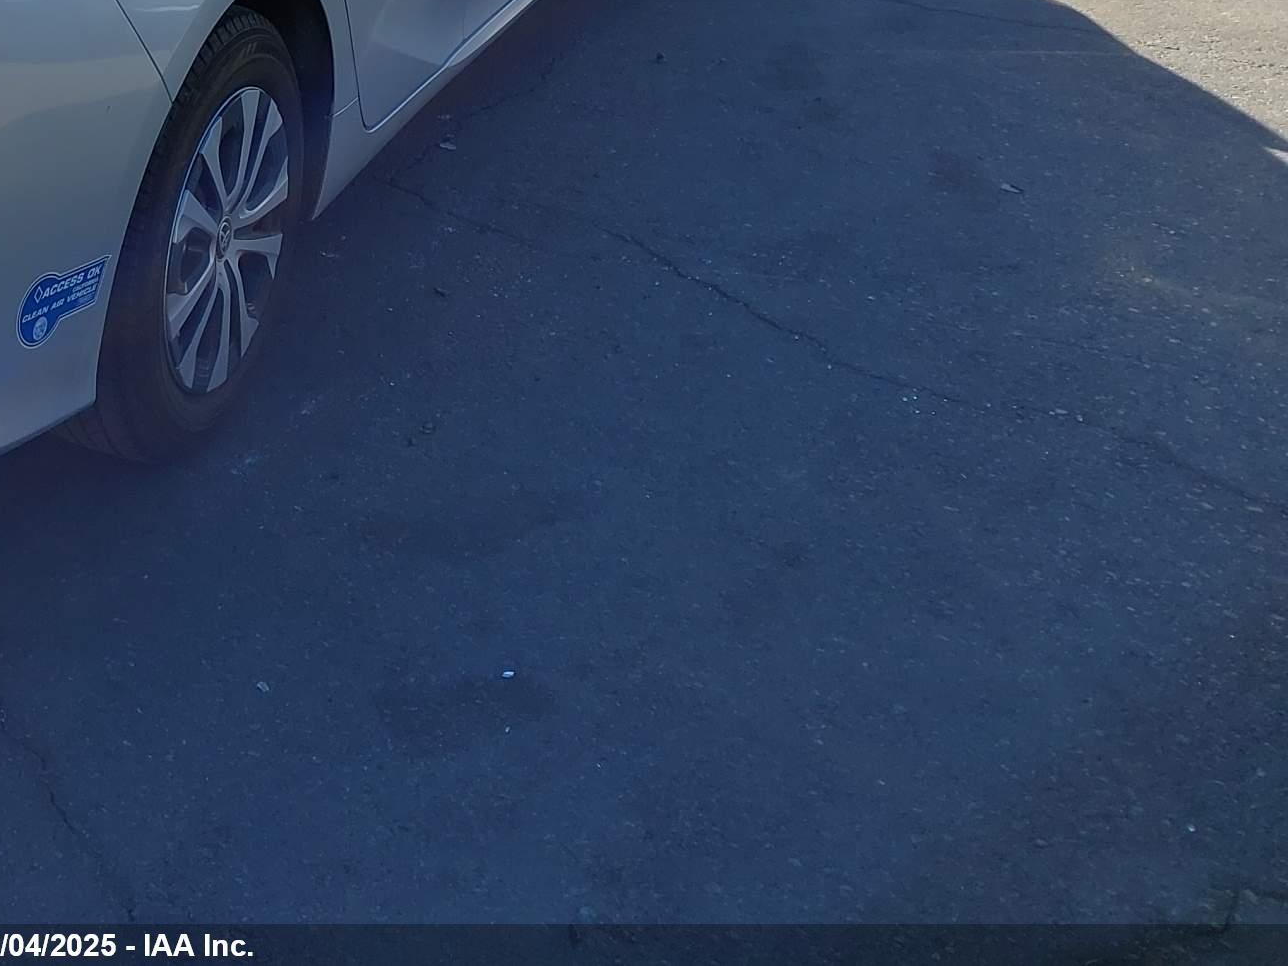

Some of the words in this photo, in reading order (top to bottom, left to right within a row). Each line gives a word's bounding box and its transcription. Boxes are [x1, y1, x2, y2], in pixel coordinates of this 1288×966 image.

[42, 273, 85, 299] ACCESS
[87, 264, 103, 279] OK
[22, 305, 49, 323] CLEAN
[50, 298, 65, 311] AIR
[67, 284, 97, 302] VEHICLE
